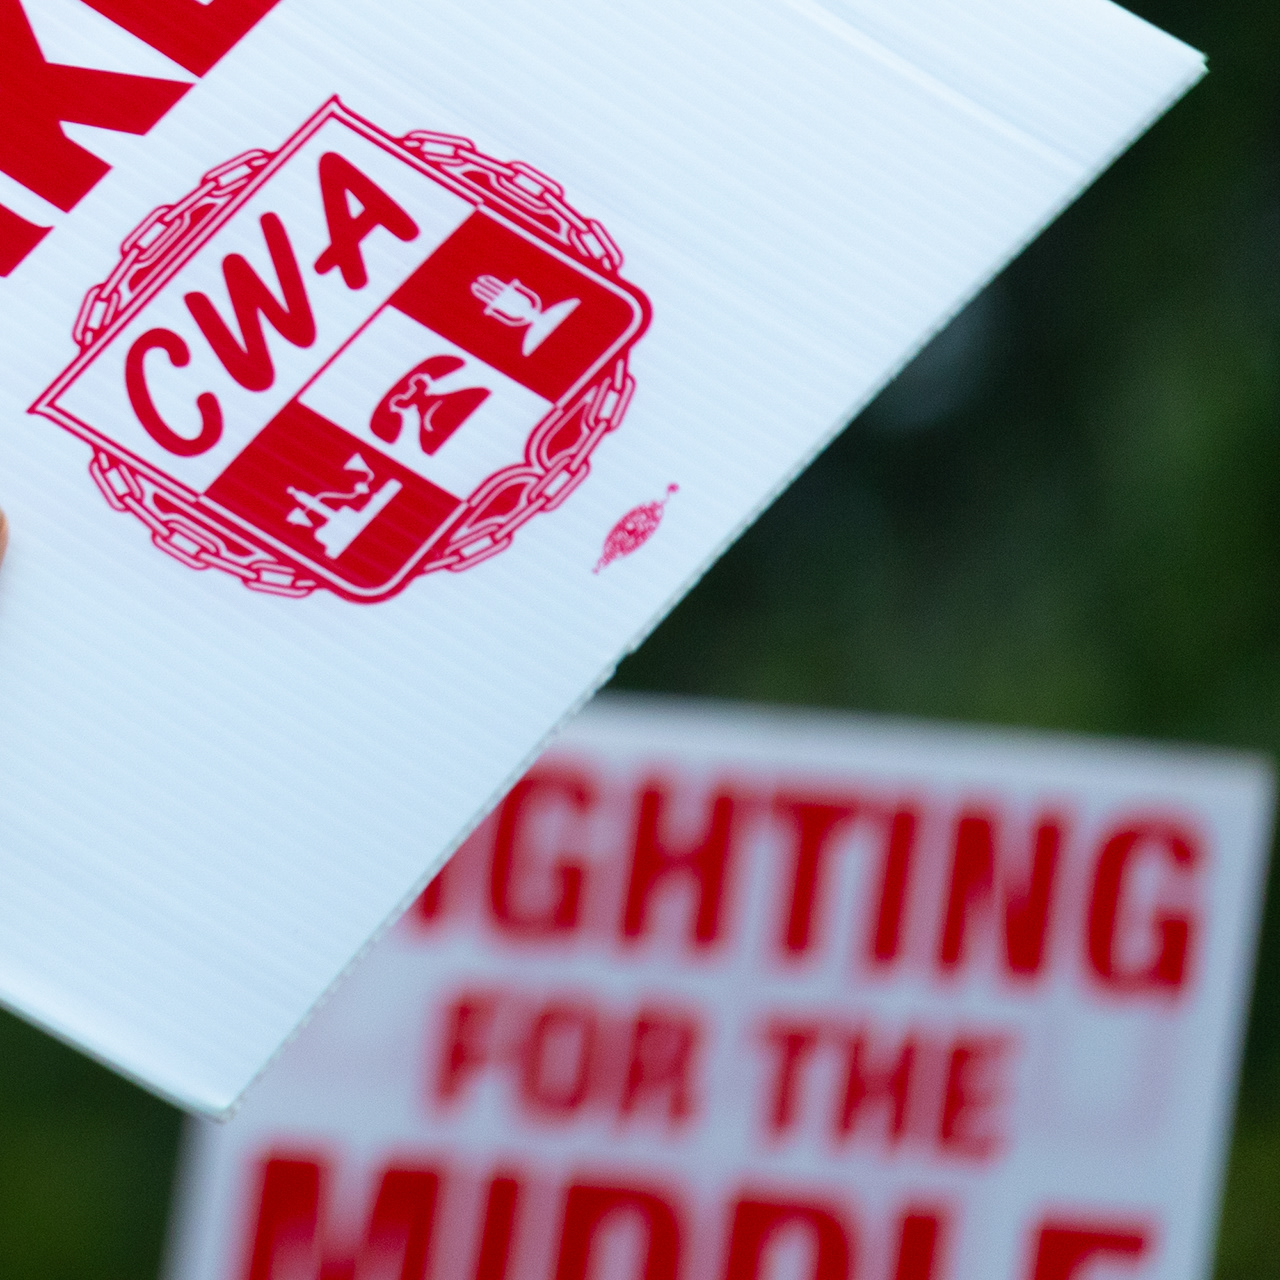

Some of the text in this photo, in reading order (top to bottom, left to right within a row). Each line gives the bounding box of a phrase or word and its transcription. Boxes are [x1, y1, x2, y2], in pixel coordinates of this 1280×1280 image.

[125, 151, 420, 457] CWA
[390, 752, 1207, 1003] GHTING
[430, 982, 1008, 1160] FOR THE
